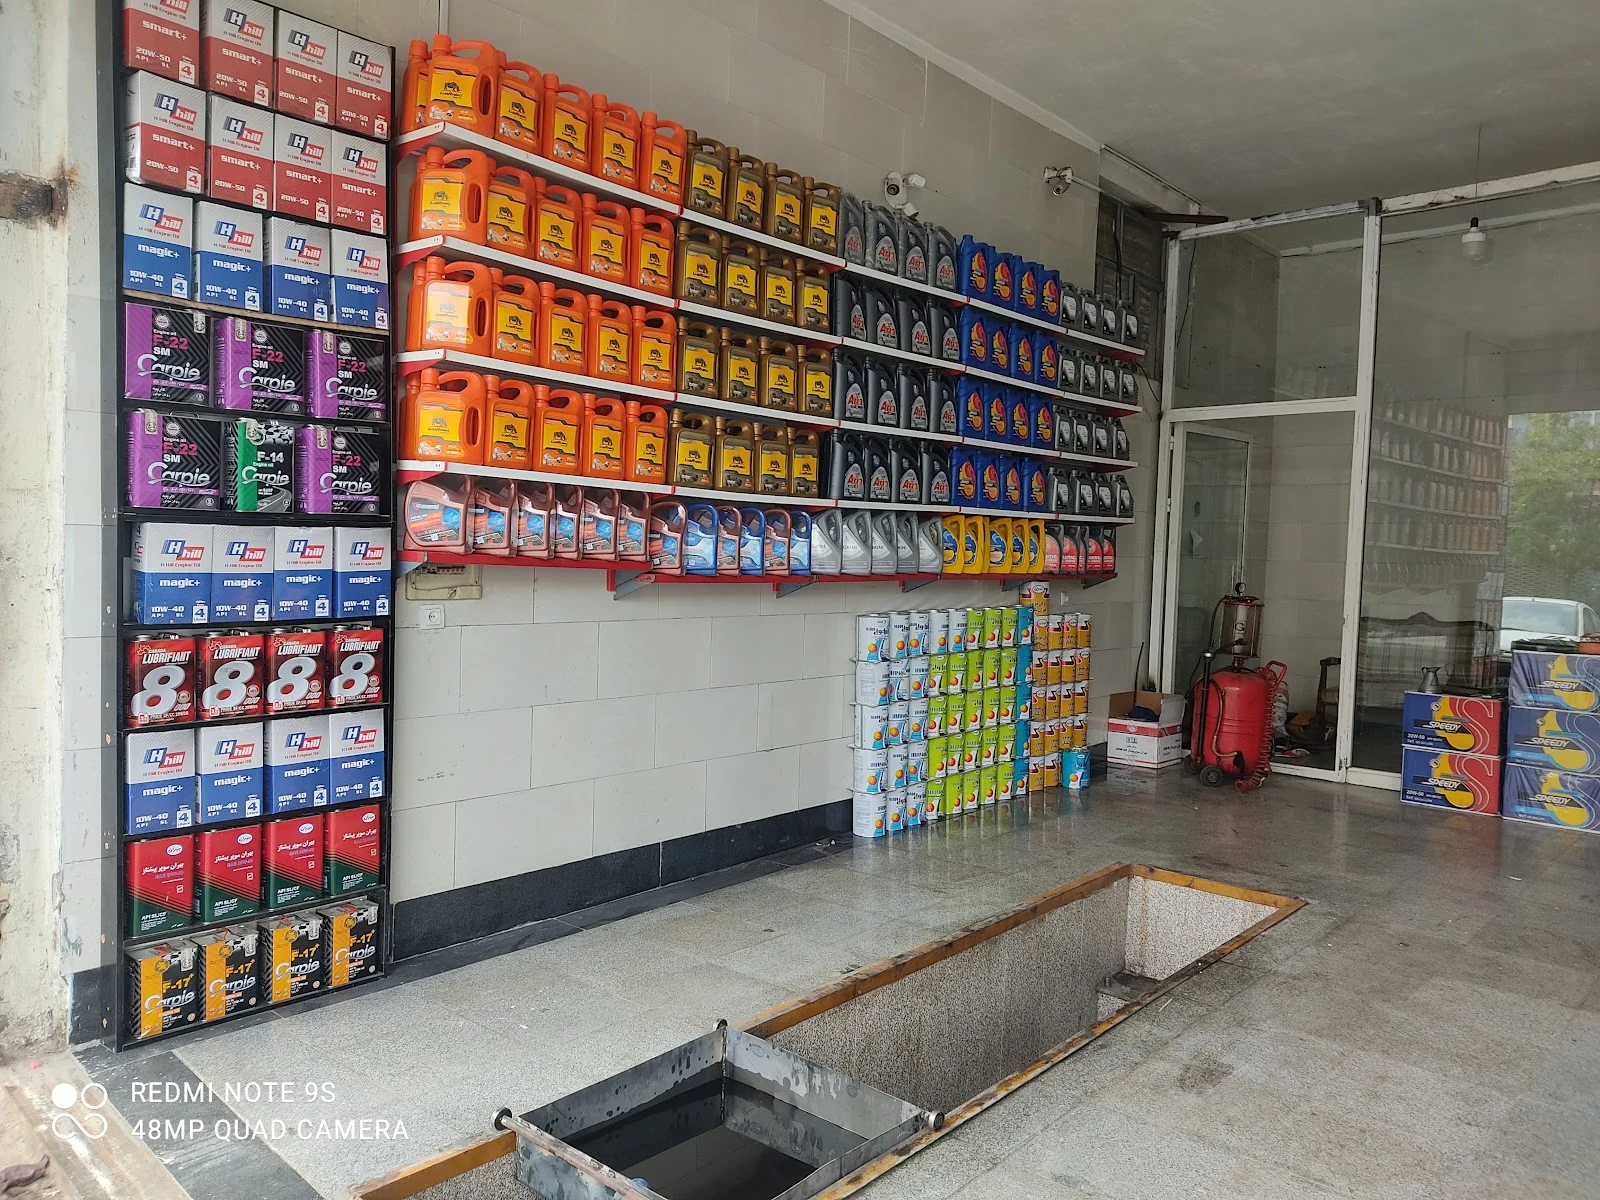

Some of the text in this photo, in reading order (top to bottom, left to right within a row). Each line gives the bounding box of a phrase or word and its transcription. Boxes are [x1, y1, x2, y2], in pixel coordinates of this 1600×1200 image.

[142, 20, 188, 41] smart+
[244, 23, 263, 38] hill
[136, 46, 171, 62] 20W-50
[307, 43, 325, 57] hill
[222, 48, 262, 65] smart+
[285, 66, 323, 83] smart+
[366, 63, 383, 77] hill
[216, 72, 247, 87] 20W-50
[279, 90, 308, 104] 20W-50
[347, 86, 381, 101] smart+
[175, 107, 195, 123] hill
[341, 109, 368, 122] 20W-50
[152, 133, 195, 150] smart+
[243, 128, 262, 144] hill
[306, 145, 323, 159] hill
[146, 160, 178, 173] 20W-50
[221, 154, 261, 170] smart+
[360, 157, 377, 171] hill
[286, 169, 322, 184] smart+
[215, 179, 245, 192] 20W-50
[342, 182, 377, 197] smart+
[281, 193, 309, 205] 20W-50
[337, 206, 364, 217] 20W-50
[161, 217, 181, 231] hill
[234, 233, 253, 246] hill
[138, 243, 179, 258] magic+
[304, 247, 321, 260] hill
[213, 258, 252, 273] magic+
[363, 257, 380, 269] hill
[129, 269, 163, 281] 10W-40
[284, 272, 320, 285] magic+
[173, 280, 185, 291] 4
[206, 285, 237, 295] 10W-40
[346, 283, 380, 294] magic+
[246, 294, 257, 304] 4
[278, 298, 307, 307] 10W-40
[315, 305, 326, 316] 4
[341, 307, 368, 316] 10W-40
[376, 314, 386, 324] 4
[152, 335, 188, 350] F-22
[153, 347, 171, 356] SM
[252, 349, 284, 363] F-22
[253, 359, 268, 369] SM
[337, 359, 366, 372] F-22
[338, 370, 352, 378] SM
[163, 442, 197, 456] F-22
[164, 454, 181, 463] SM
[257, 451, 284, 463] F-14
[332, 455, 361, 467] F-22
[333, 465, 347, 474] SM
[180, 548, 202, 560] hill
[244, 550, 264, 561] hill
[305, 547, 323, 558] hill
[366, 549, 383, 559] hill
[159, 579, 200, 588] magic+
[224, 579, 262, 588] magic+
[286, 575, 322, 584] magic+
[350, 576, 382, 584] magic+
[256, 607, 267, 616] 4
[317, 602, 327, 612] 4
[378, 601, 386, 611] 4
[195, 609, 205, 619] 4
[277, 644, 322, 655] LUBRIFIANT
[340, 640, 381, 651] LUBRIFIANT
[142, 651, 191, 665] LUBRIFIANT
[214, 647, 261, 660] LUBRIFIANT
[266, 656, 317, 703] 8
[329, 652, 375, 698] 8
[202, 660, 255, 709] 8
[1536, 680, 1579, 690] SPEEDY
[131, 665, 185, 717] 8
[1424, 721, 1461, 731] SPEEDY
[360, 732, 376, 742] hill
[304, 738, 321, 749] hill
[1526, 738, 1570, 748] SPEEDY
[234, 746, 254, 758] hill
[164, 754, 184, 767] hill
[342, 758, 375, 769] magic+
[284, 766, 319, 777] magic+
[214, 775, 252, 786] magic+
[1423, 778, 1460, 788] SPEEDY
[143, 785, 183, 796] magic+
[336, 784, 363, 792] 10W-40
[371, 783, 380, 792] 4
[278, 792, 306, 802] 10W-40
[315, 792, 325, 802] 4
[1528, 794, 1571, 804] SPEEDY
[207, 802, 238, 811] 10W-40
[247, 802, 258, 811] 4
[136, 813, 168, 823] 10W-40
[178, 813, 189, 823] 4
